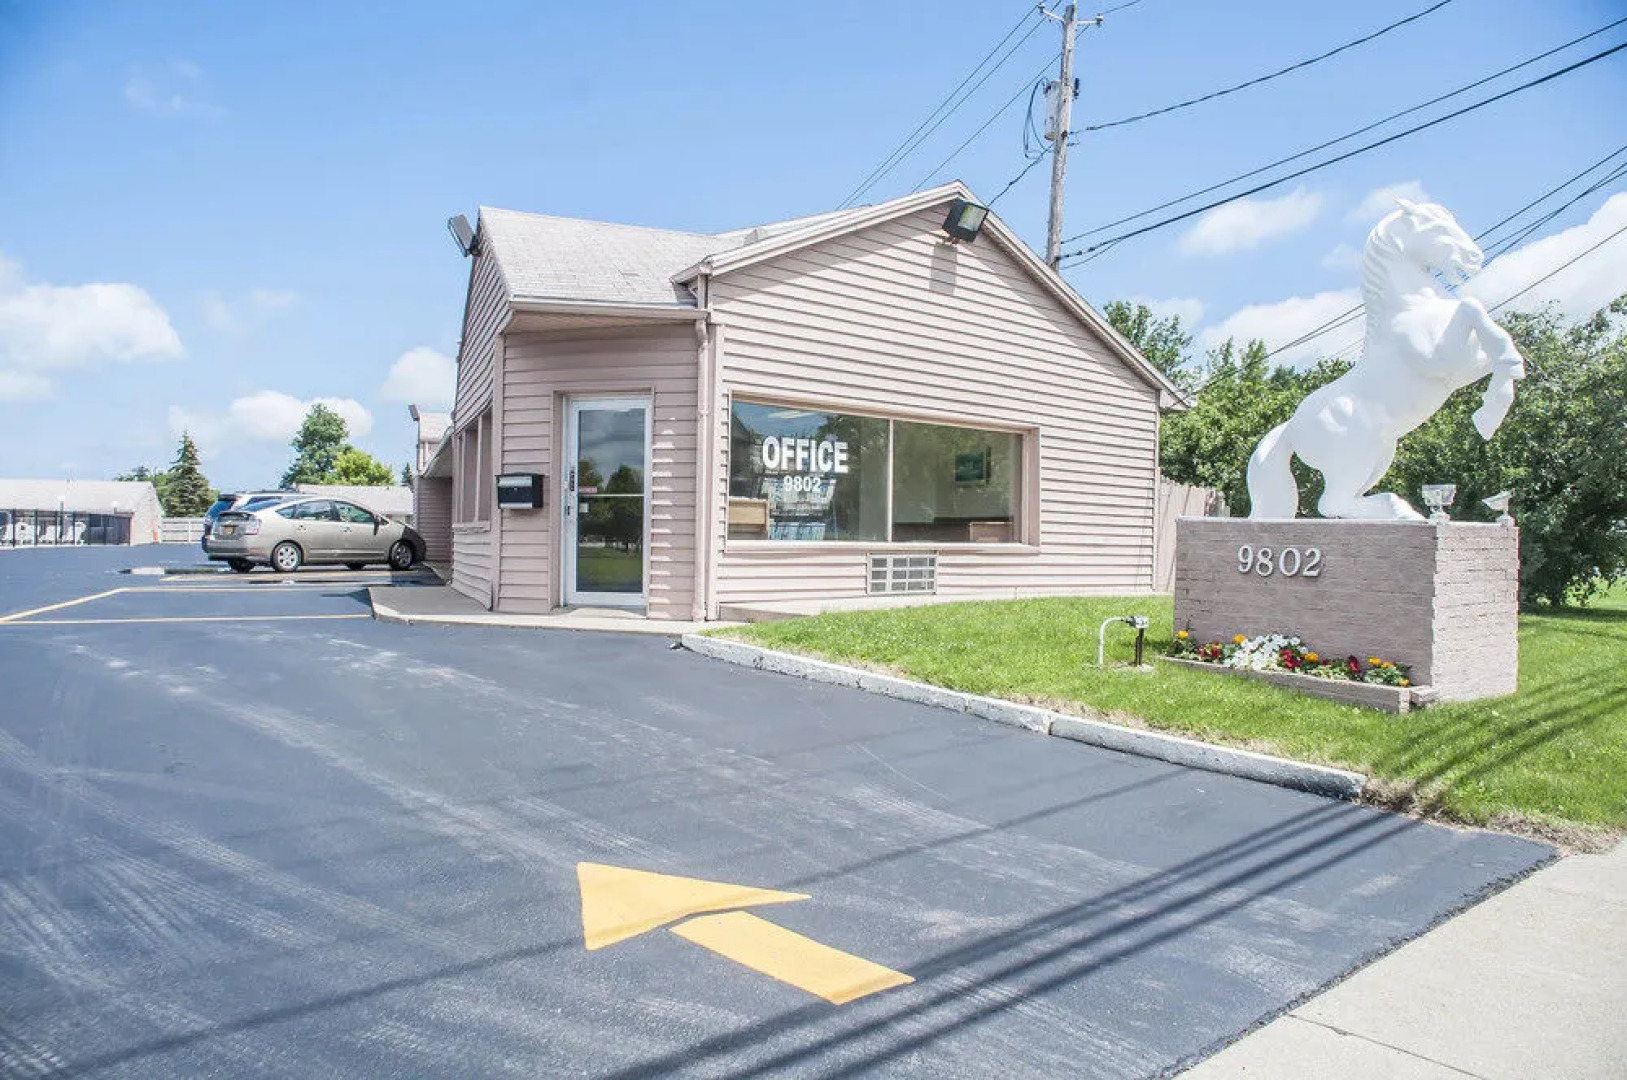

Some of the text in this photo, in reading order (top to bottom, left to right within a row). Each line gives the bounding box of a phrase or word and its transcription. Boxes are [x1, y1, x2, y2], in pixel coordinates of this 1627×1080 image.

[763, 436, 848, 473] OFFICE
[783, 475, 820, 492] 9802
[1238, 545, 1320, 576] 9802
